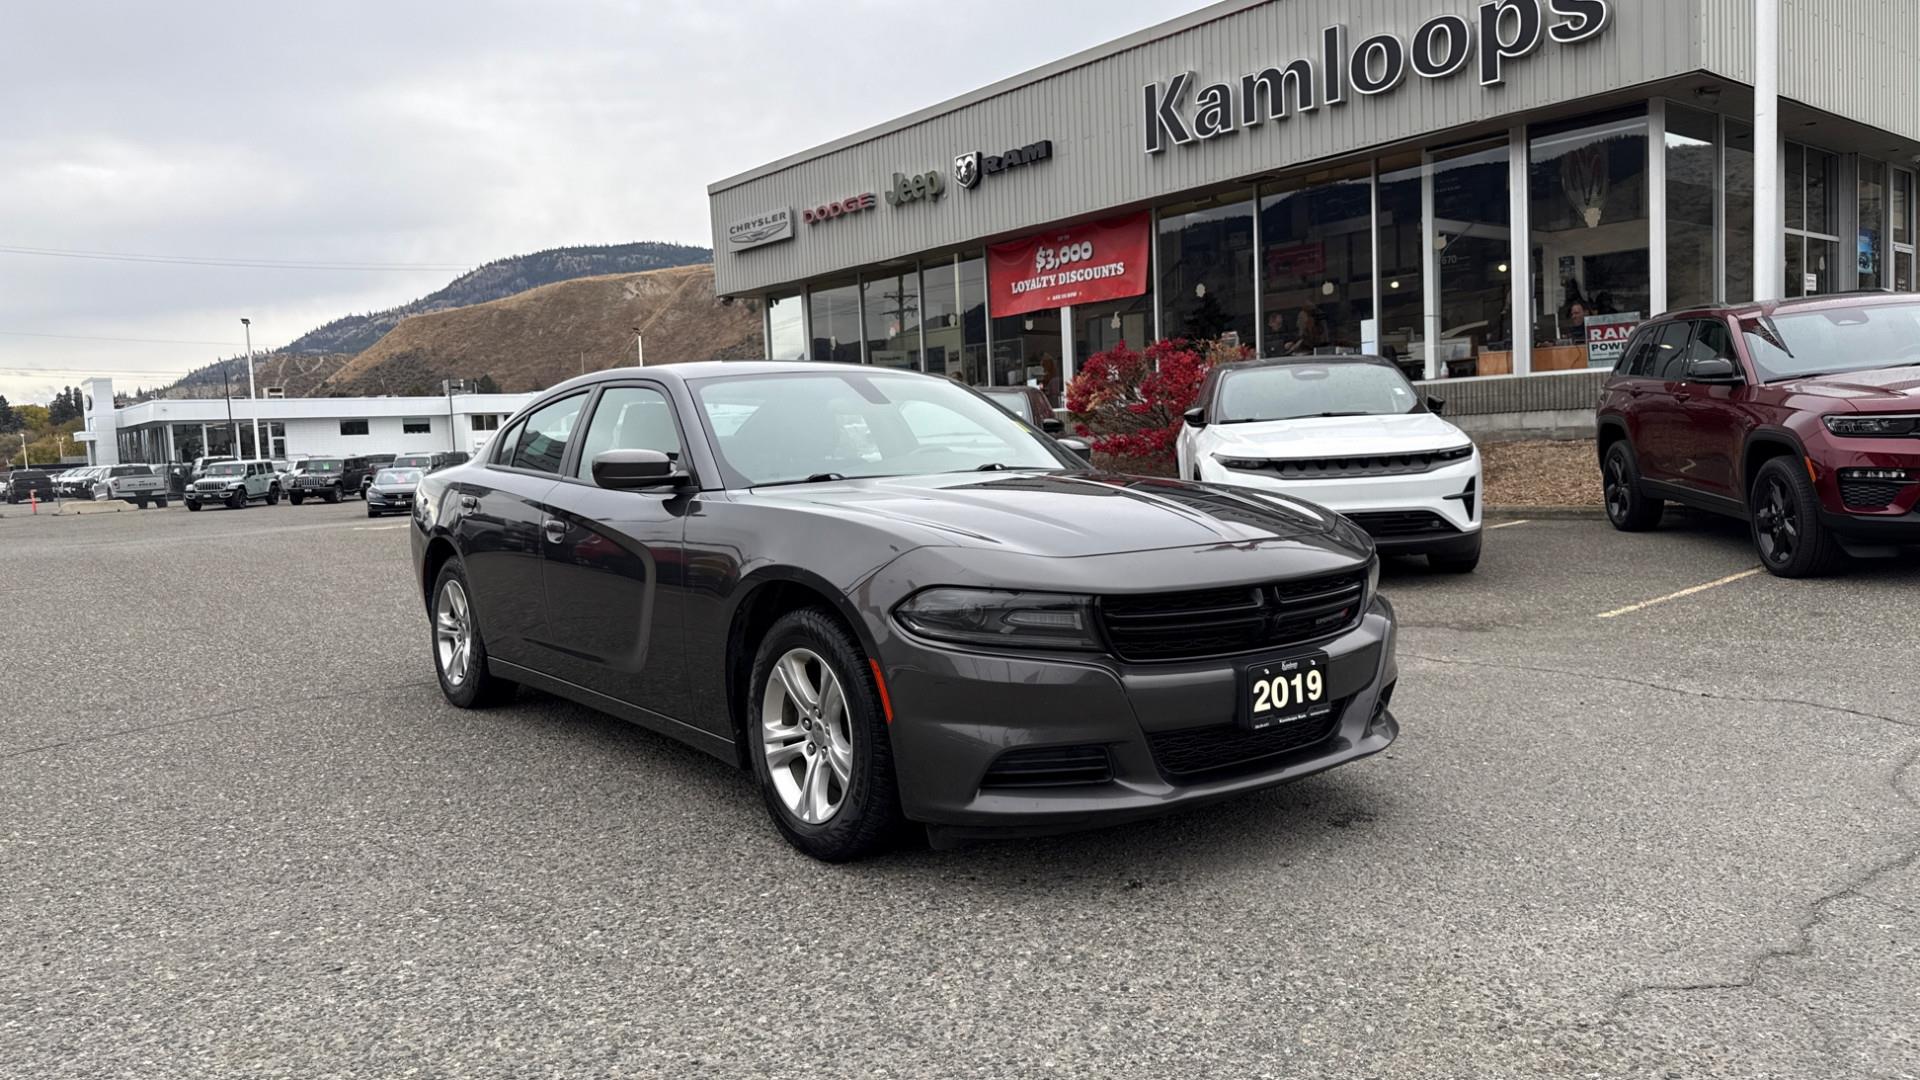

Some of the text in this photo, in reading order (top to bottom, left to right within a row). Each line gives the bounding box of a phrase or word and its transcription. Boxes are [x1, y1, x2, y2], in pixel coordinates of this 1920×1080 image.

[1144, 0, 1609, 153] Kamloops
[982, 140, 1052, 175] RAM
[885, 170, 944, 205] Jeep
[729, 211, 787, 234] CHRYSLER
[803, 193, 876, 224] DODGE
[1036, 241, 1093, 272] $3,000
[1011, 262, 1125, 294] LOYALTY DISCOUNTS
[1590, 326, 1635, 340] RAM
[1253, 669, 1323, 713] 2019
